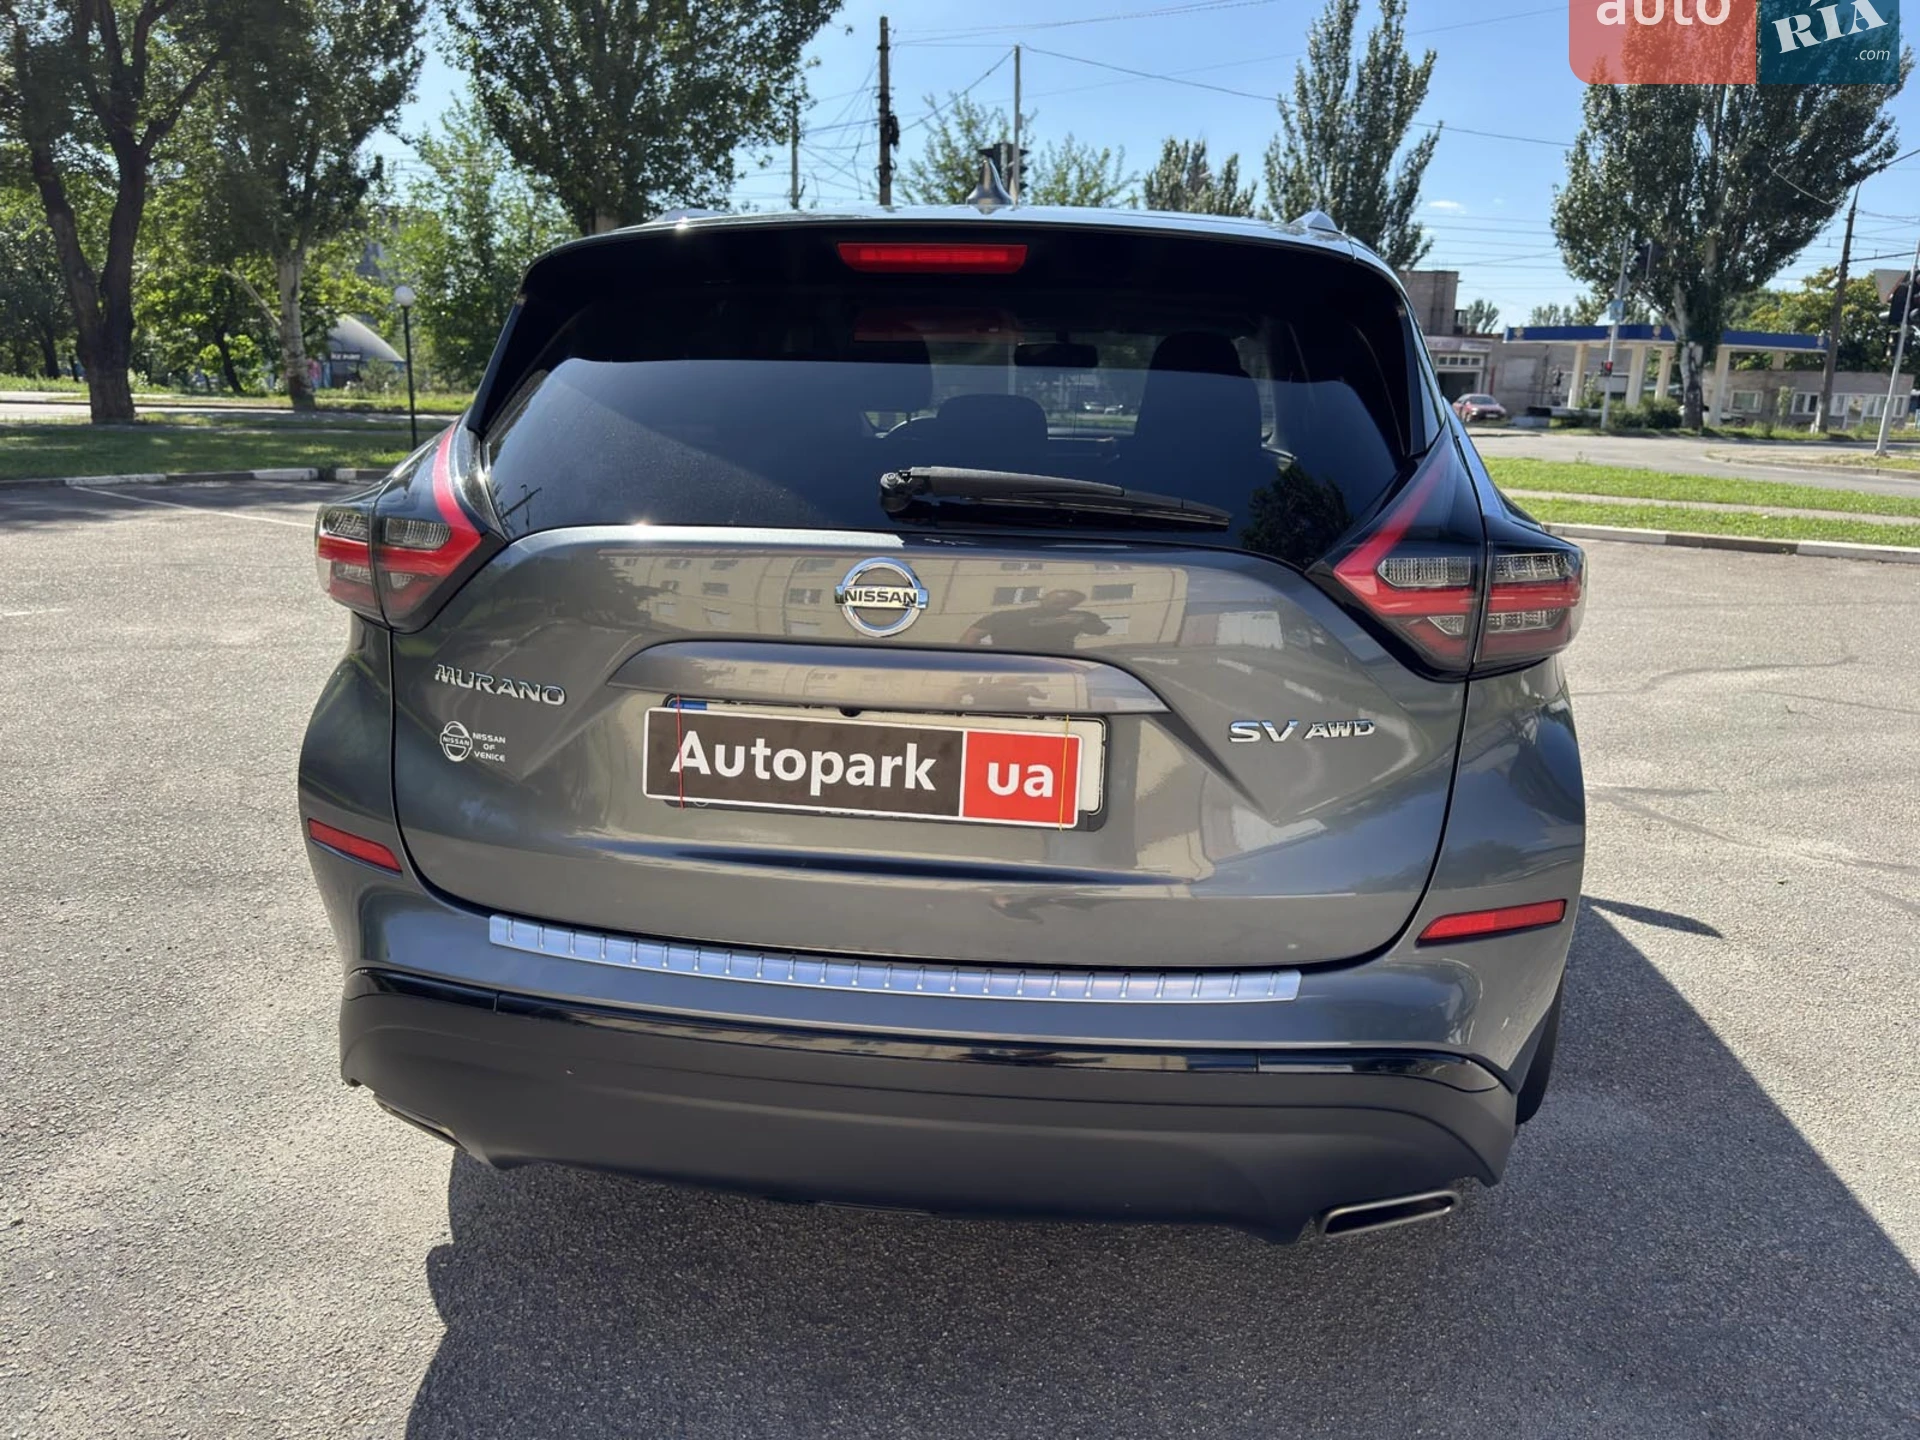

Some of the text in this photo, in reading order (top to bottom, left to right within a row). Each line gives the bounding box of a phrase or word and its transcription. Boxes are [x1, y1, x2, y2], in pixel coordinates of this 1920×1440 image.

[844, 590, 917, 604] NISSAN
[434, 663, 566, 706] MURANO
[472, 732, 506, 744] NISSAN
[1229, 719, 1376, 743] SV AWD
[442, 735, 471, 746] NISSAN
[473, 750, 506, 762] VENICE
[670, 730, 1055, 799] Autopark ua
